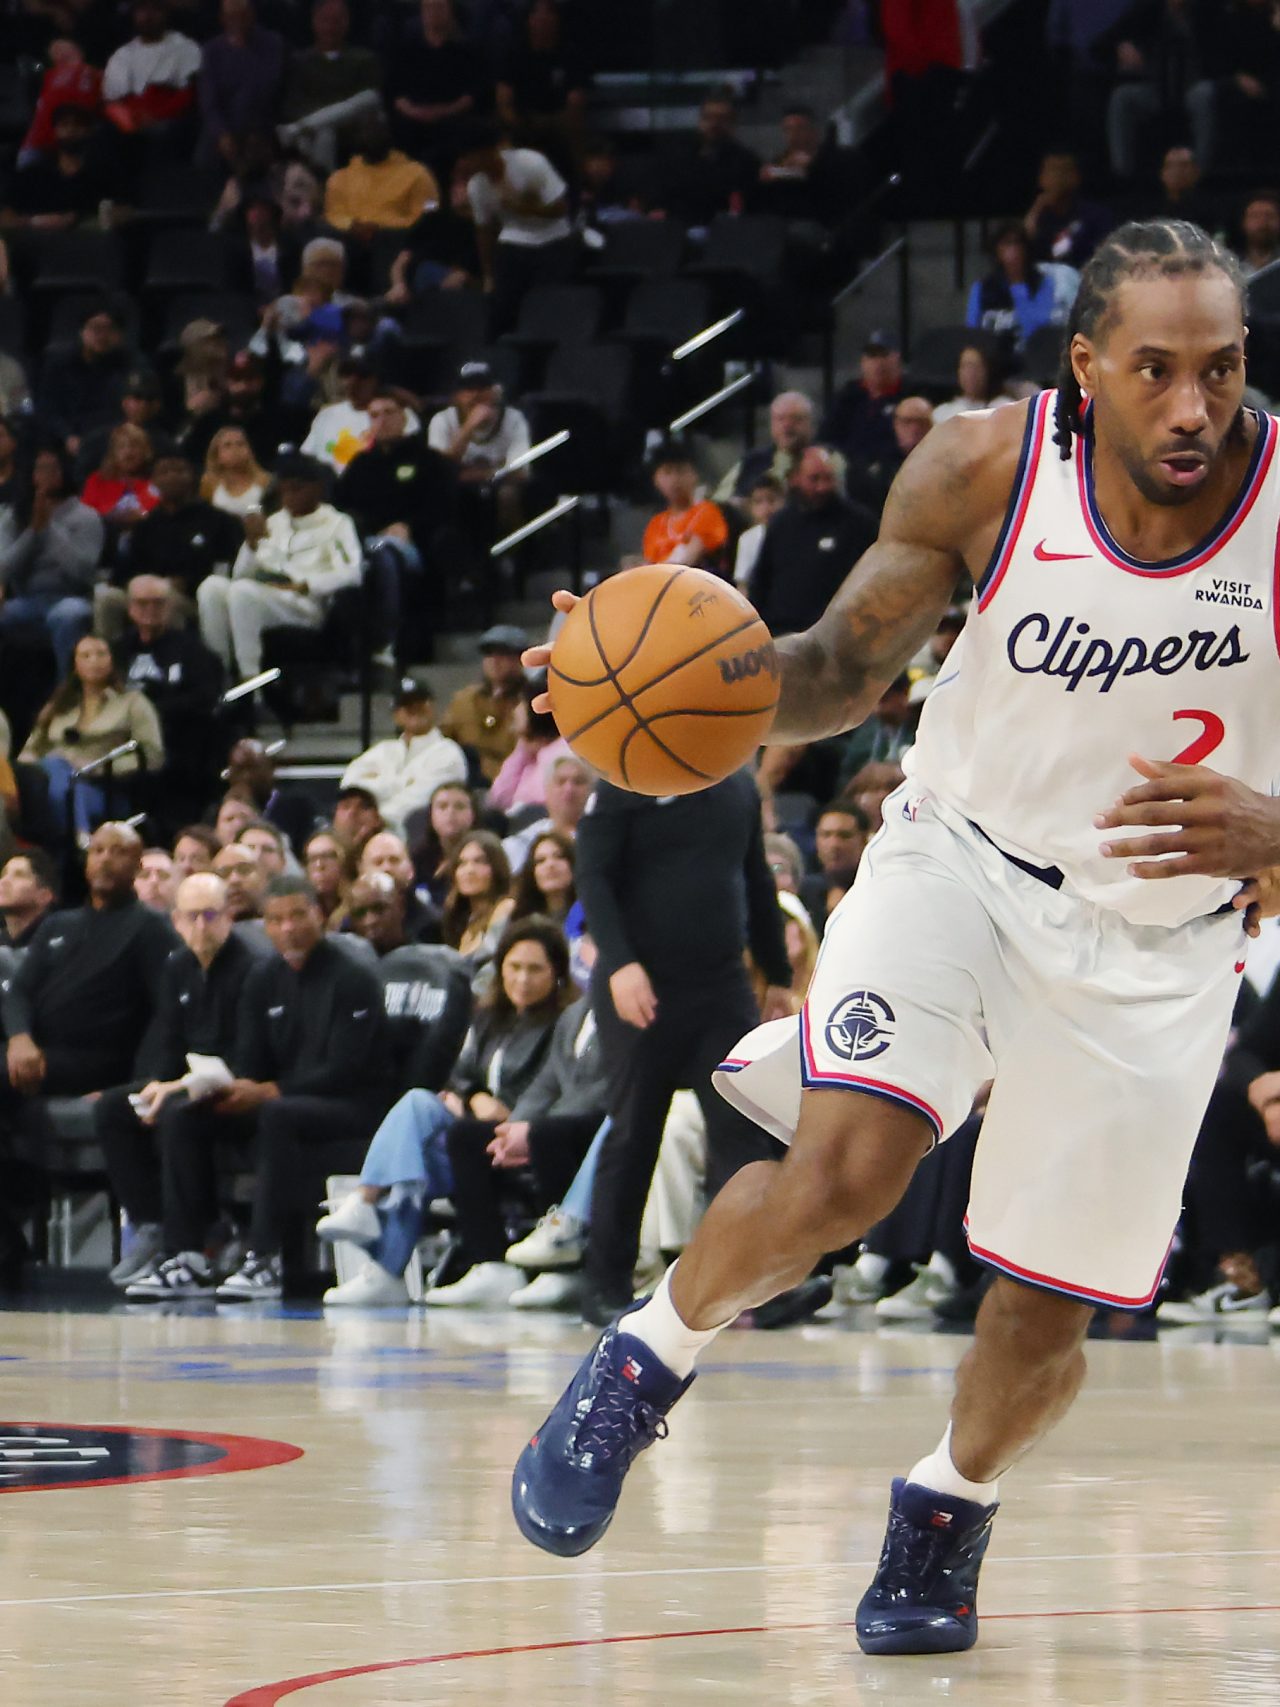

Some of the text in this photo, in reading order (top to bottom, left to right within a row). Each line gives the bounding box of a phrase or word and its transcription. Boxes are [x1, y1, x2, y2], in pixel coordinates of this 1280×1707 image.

[1195, 590, 1263, 609] RWANDA
[1212, 579, 1251, 594] VISIT
[1006, 613, 1250, 692] Clippers
[1171, 709, 1225, 765] 2
